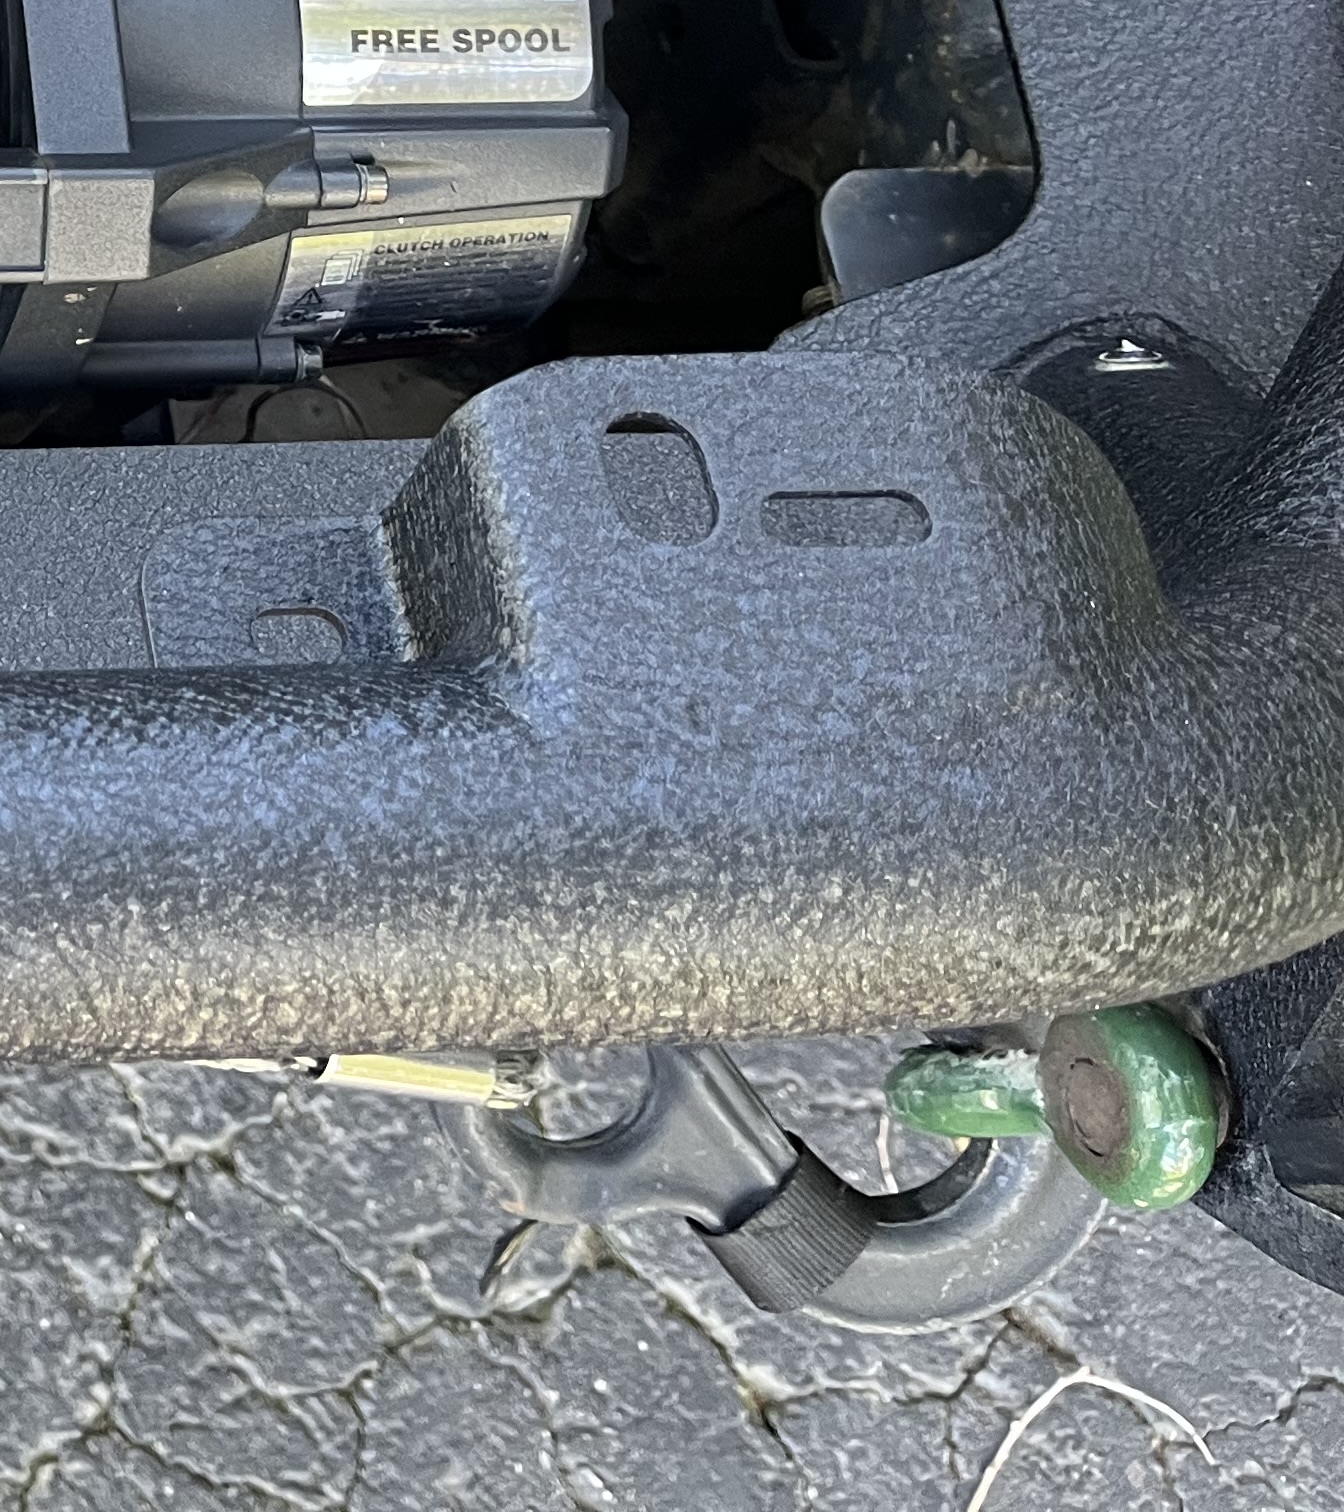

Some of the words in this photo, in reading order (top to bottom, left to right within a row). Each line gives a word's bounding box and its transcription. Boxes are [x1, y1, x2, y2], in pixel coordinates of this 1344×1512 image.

[350, 29, 441, 54] FREE
[452, 28, 571, 53] SPOOL
[373, 239, 447, 256] CLUTCH
[448, 230, 550, 248] OPERATION
